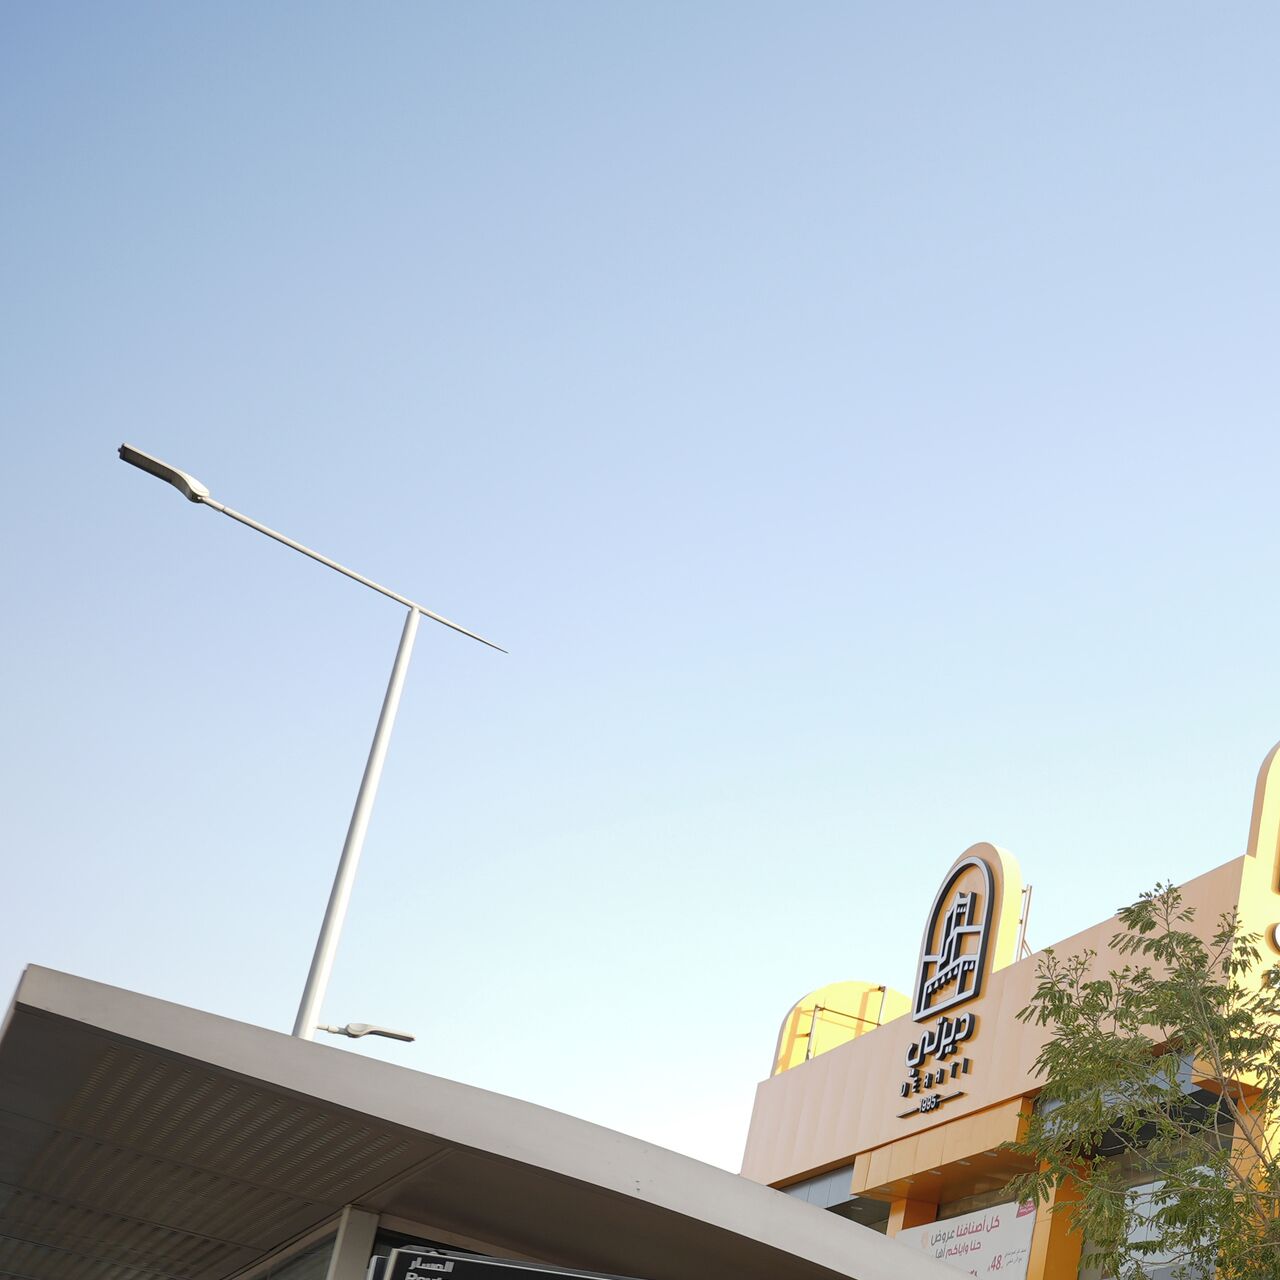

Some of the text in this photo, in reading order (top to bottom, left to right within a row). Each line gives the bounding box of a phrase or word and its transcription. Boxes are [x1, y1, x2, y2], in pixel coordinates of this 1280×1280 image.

[905, 1012, 975, 1067] ديرتي
[986, 1215, 999, 1233] كل
[930, 1230, 955, 1246] عروض
[408, 1256, 454, 1273] المسار
